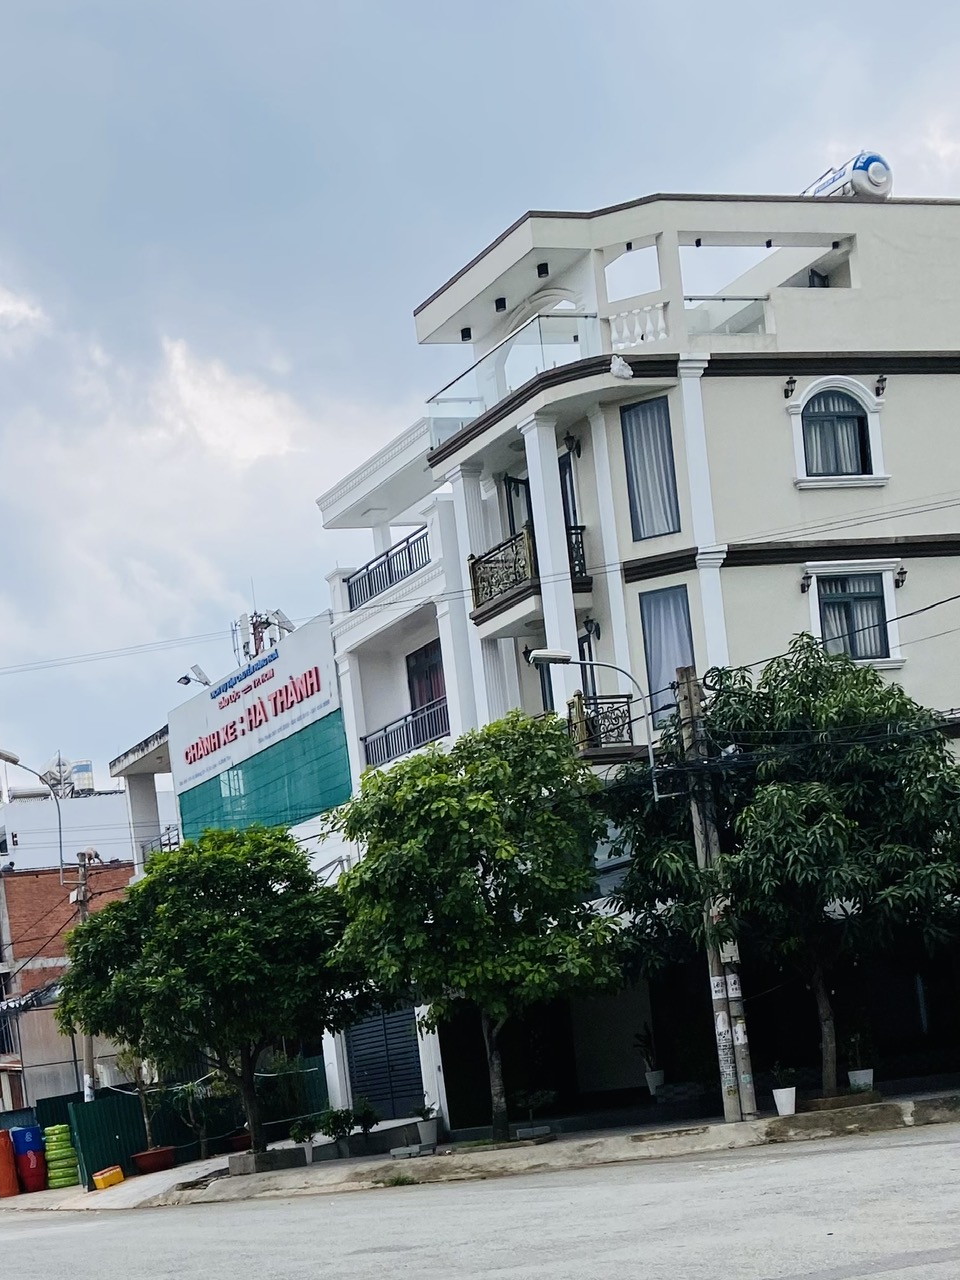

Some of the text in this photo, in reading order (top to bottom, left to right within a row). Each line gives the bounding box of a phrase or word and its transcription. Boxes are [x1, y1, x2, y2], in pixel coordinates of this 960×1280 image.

[183, 731, 221, 765] CHÀNH
[219, 720, 238, 746] XE
[244, 696, 269, 732] HÀ
[267, 666, 321, 717] THÀNH
